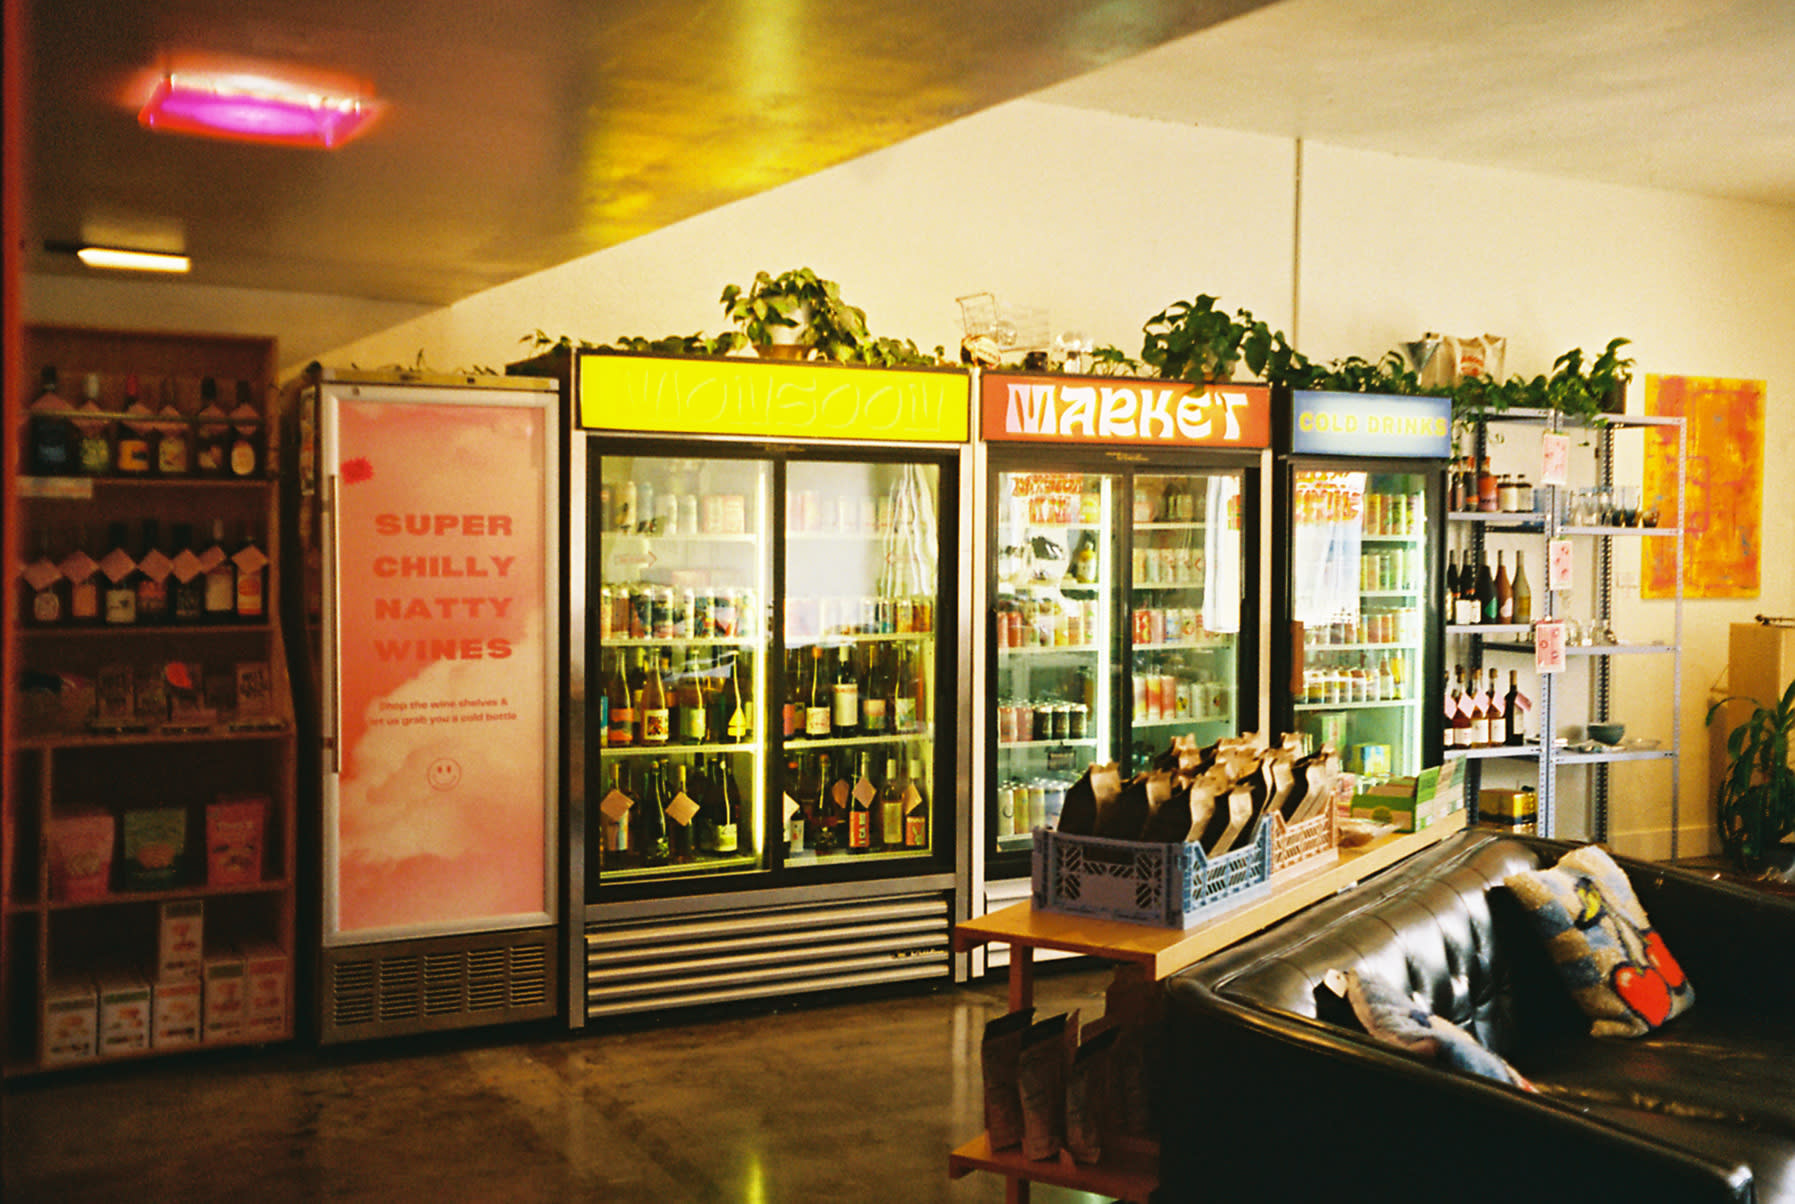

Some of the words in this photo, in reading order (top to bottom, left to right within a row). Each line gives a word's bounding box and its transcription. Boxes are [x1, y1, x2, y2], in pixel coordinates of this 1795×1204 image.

[618, 367, 944, 433] MONSOON
[1006, 384, 1248, 440] MARKET
[1299, 412, 1358, 432] COLD
[1368, 416, 1448, 436] DRINKS
[375, 513, 513, 537] SUPER
[373, 556, 516, 578] CHILLY
[375, 597, 513, 620] NATTY
[374, 637, 513, 661] WINES
[410, 700, 428, 709] the
[430, 700, 456, 709] wine
[459, 698, 498, 708] shelves
[501, 698, 509, 706] &
[387, 718, 400, 726] us
[401, 716, 427, 726] grab
[430, 716, 449, 725] you
[460, 713, 484, 722] cold
[486, 711, 518, 721] bottle
